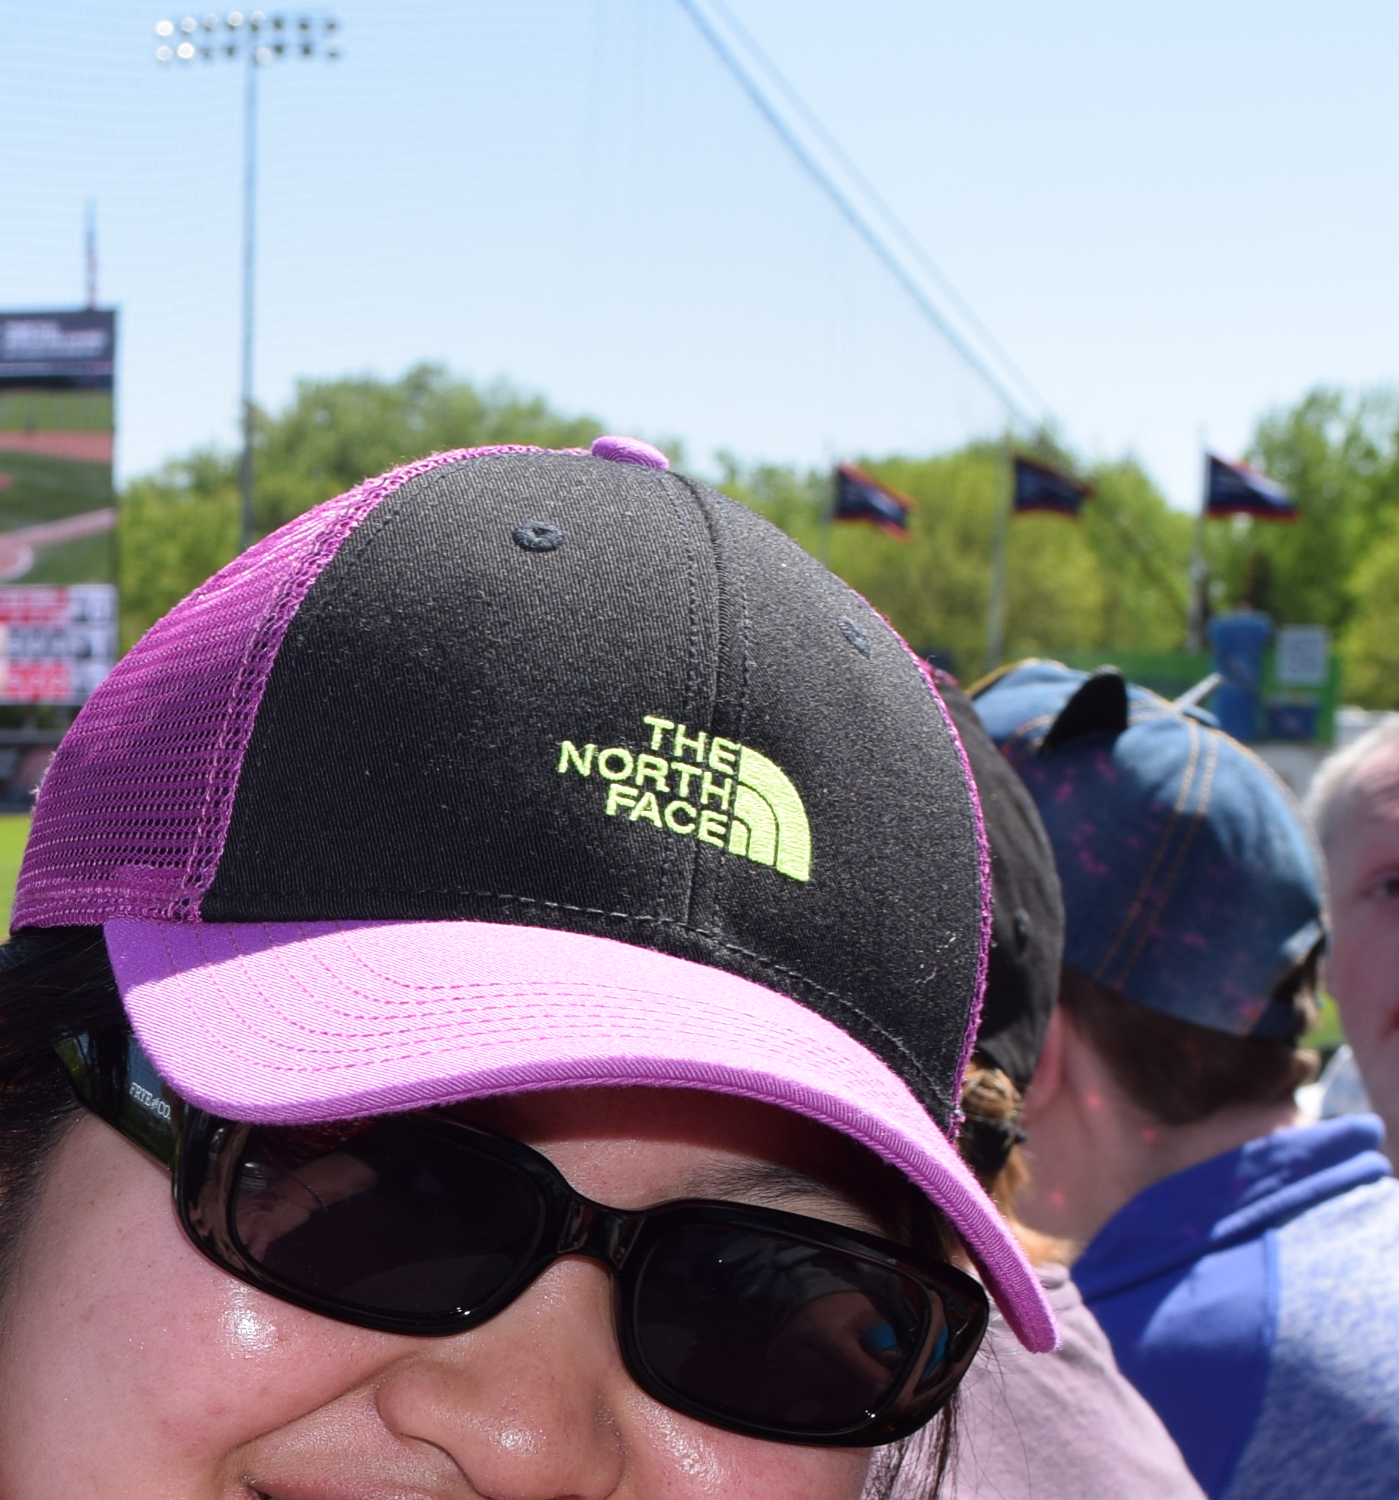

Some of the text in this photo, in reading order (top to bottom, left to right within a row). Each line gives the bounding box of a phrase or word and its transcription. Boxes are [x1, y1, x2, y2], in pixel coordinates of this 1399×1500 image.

[557, 740, 733, 811] NORTH
[643, 715, 741, 776] THE
[605, 783, 729, 848] FACE
